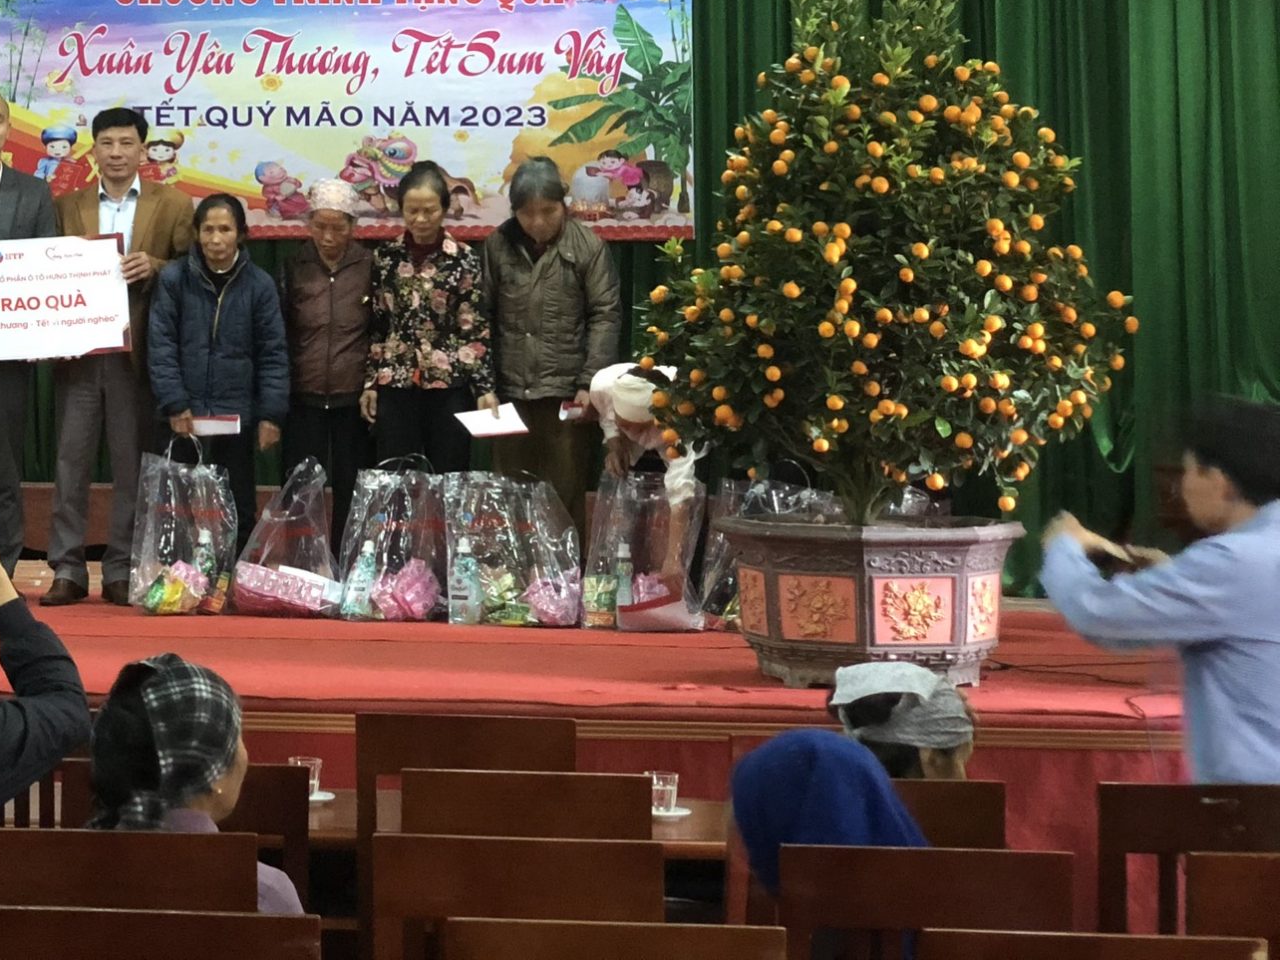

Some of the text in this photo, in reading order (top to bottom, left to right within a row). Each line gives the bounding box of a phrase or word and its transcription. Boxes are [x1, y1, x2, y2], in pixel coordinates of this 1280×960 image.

[53, 24, 154, 85] Xuân
[163, 31, 236, 95] Yêu
[242, 27, 380, 96] Thương,
[392, 29, 467, 77] Tết
[457, 30, 546, 77] Sum
[132, 98, 547, 130] TẾT QUÝ MÃO NĂM 2023
[44, 288, 87, 311] QUÀ
